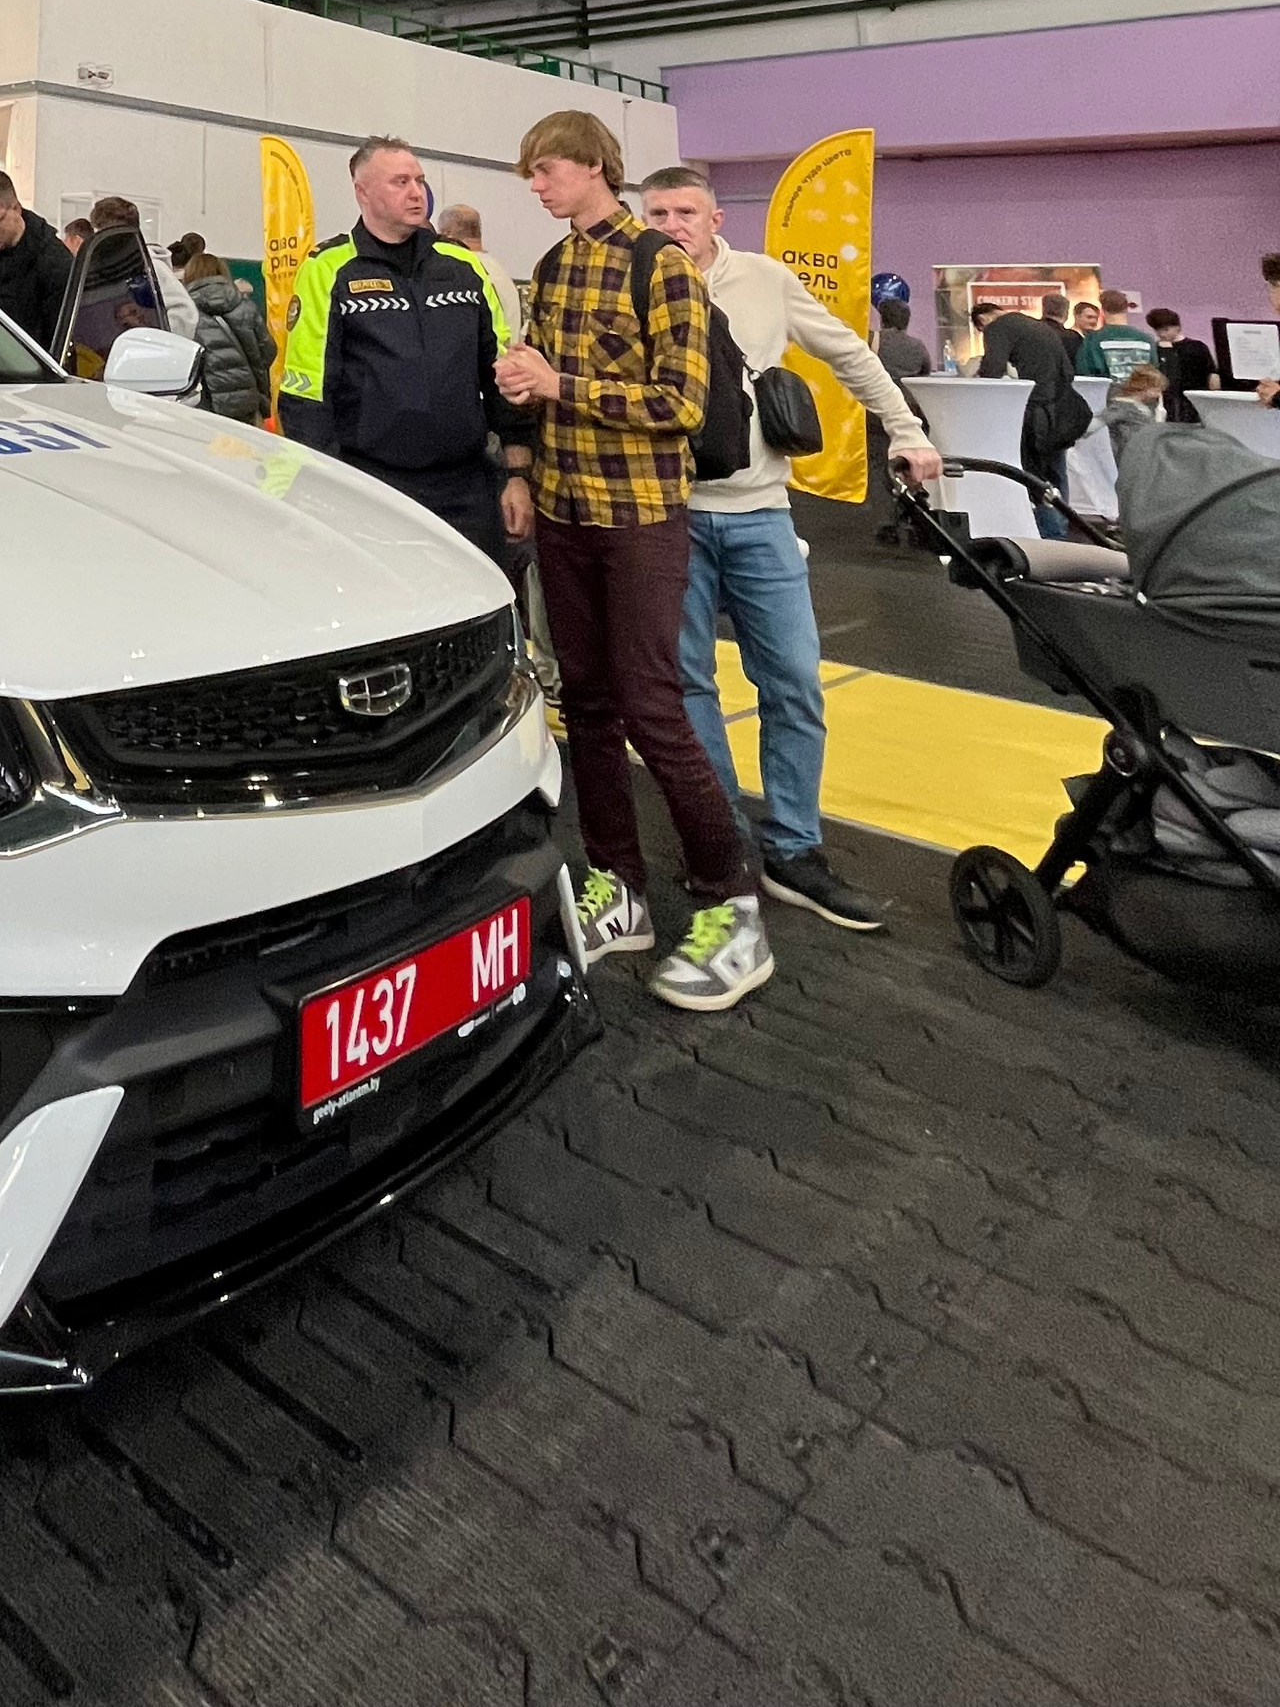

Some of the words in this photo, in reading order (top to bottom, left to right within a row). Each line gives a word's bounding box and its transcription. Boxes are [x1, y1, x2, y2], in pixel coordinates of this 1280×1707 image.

[802, 165, 822, 184] чудо
[782, 249, 838, 269] аква
[798, 271, 838, 290] ель
[976, 295, 1019, 306] COOKERY
[605, 917, 624, 940] N
[326, 963, 417, 1082] 1437
